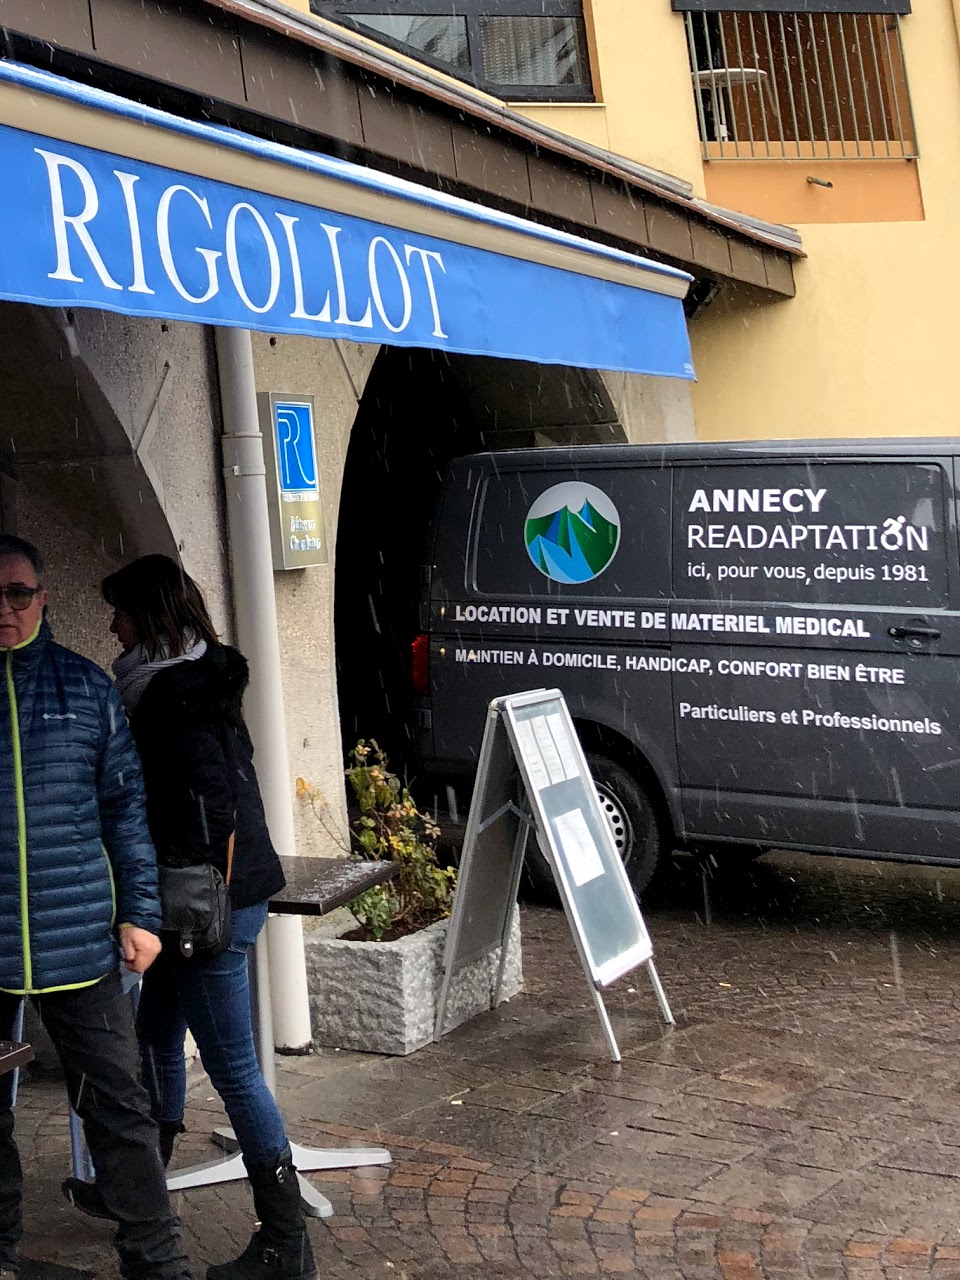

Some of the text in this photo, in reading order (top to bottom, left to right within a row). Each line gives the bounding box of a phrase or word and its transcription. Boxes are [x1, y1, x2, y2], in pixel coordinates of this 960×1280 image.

[34, 147, 446, 339] RIGOLLOT
[687, 489, 828, 514] ANNECY
[687, 516, 929, 551] READAPTATION
[687, 562, 711, 580] ici,
[717, 564, 759, 581] pour
[813, 563, 876, 583] depuis
[881, 564, 929, 582] 1981
[455, 605, 871, 638] LOCATION ET VENTE DE MATERIEL MEDICAL
[455, 648, 905, 685] MAINTIEN À DOMICILE, HANDICAP, CONFORT BIEN ÊTRE
[679, 702, 942, 735] Particuliers et Professionnels
